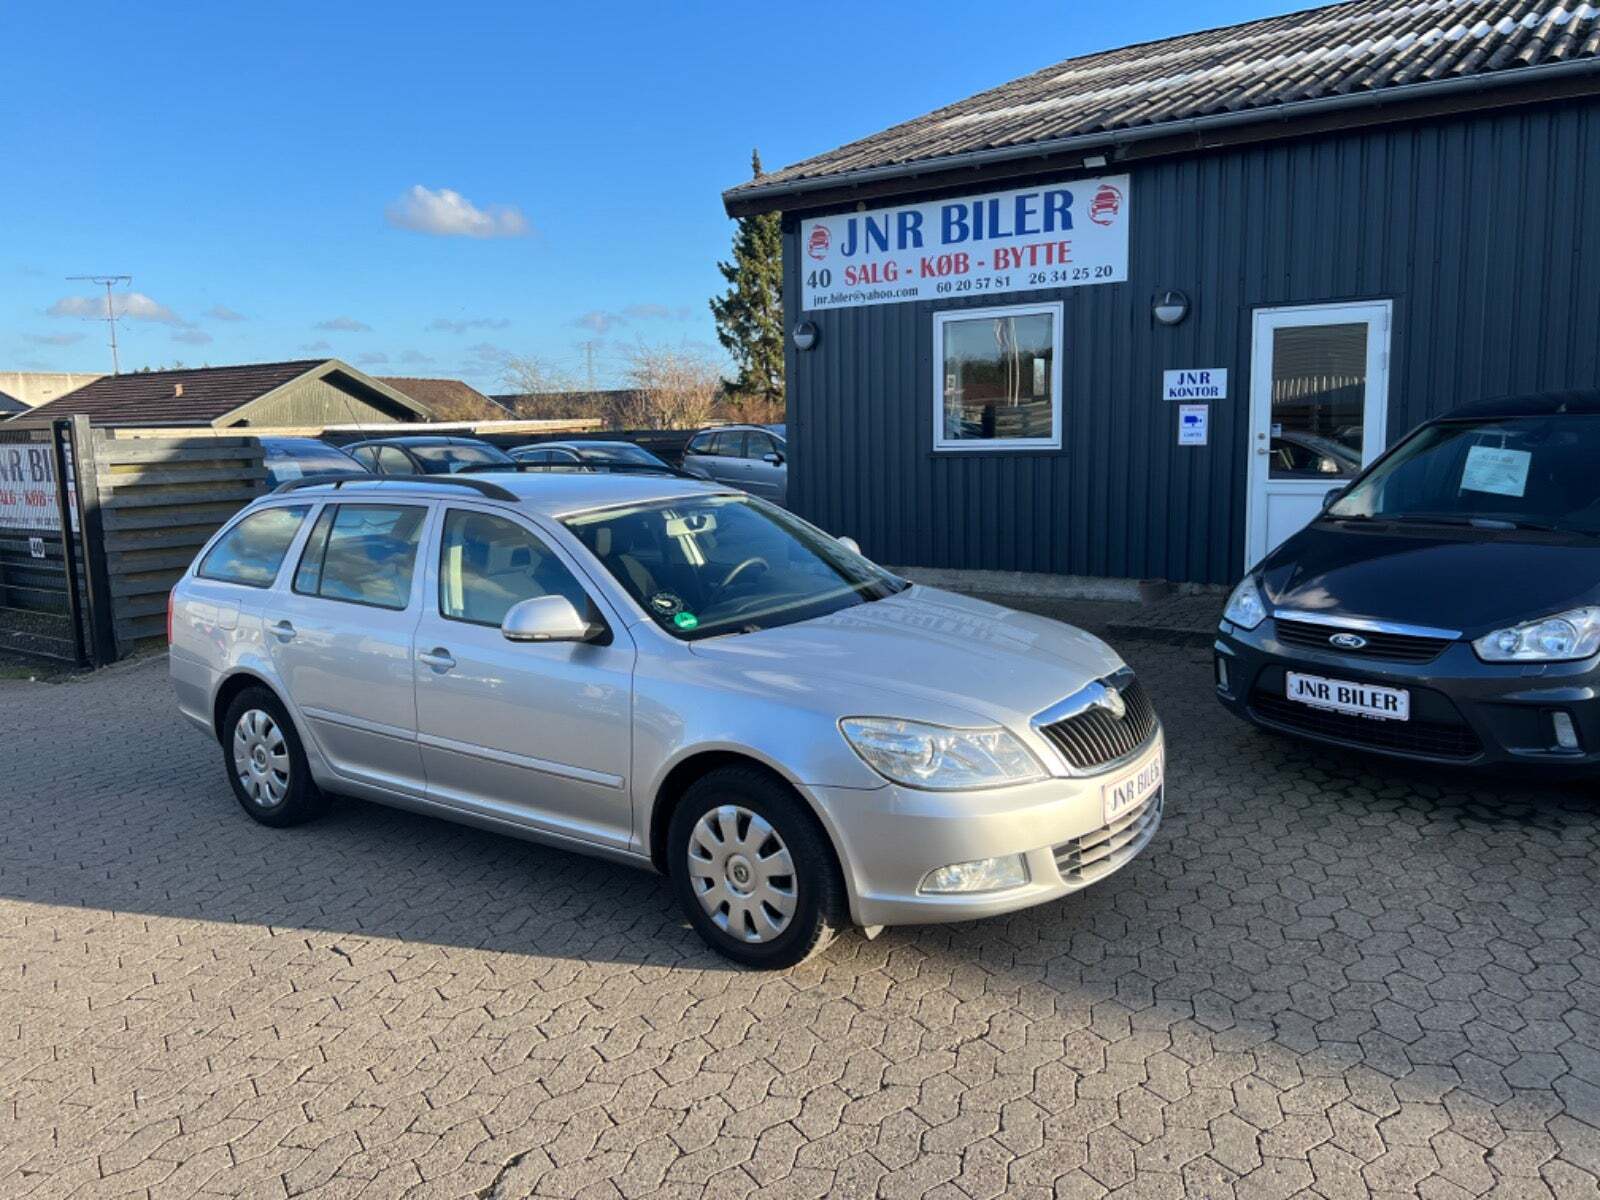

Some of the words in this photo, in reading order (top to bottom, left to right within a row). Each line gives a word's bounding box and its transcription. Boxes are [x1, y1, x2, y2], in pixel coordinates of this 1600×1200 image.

[841, 210, 924, 257] JNR
[941, 189, 1074, 245] BILER
[845, 261, 898, 286] SALG
[920, 252, 969, 279] KØB
[993, 240, 1073, 271] BYTTE
[807, 269, 832, 288] 40
[1029, 271, 1046, 284] 26
[1050, 269, 1067, 282] 34
[1072, 267, 1089, 281] 25
[1094, 265, 1113, 278] 20
[936, 281, 951, 294] 60
[956, 279, 971, 291] 20
[976, 277, 991, 289] 57
[995, 276, 1010, 288] 81
[1177, 371, 1210, 385] JNR
[1169, 386, 1218, 397] KONTOR
[1296, 679, 1330, 700] JNR
[1338, 687, 1398, 711] BILER
[1111, 780, 1134, 811] JNR
[1138, 758, 1159, 794] BILER
